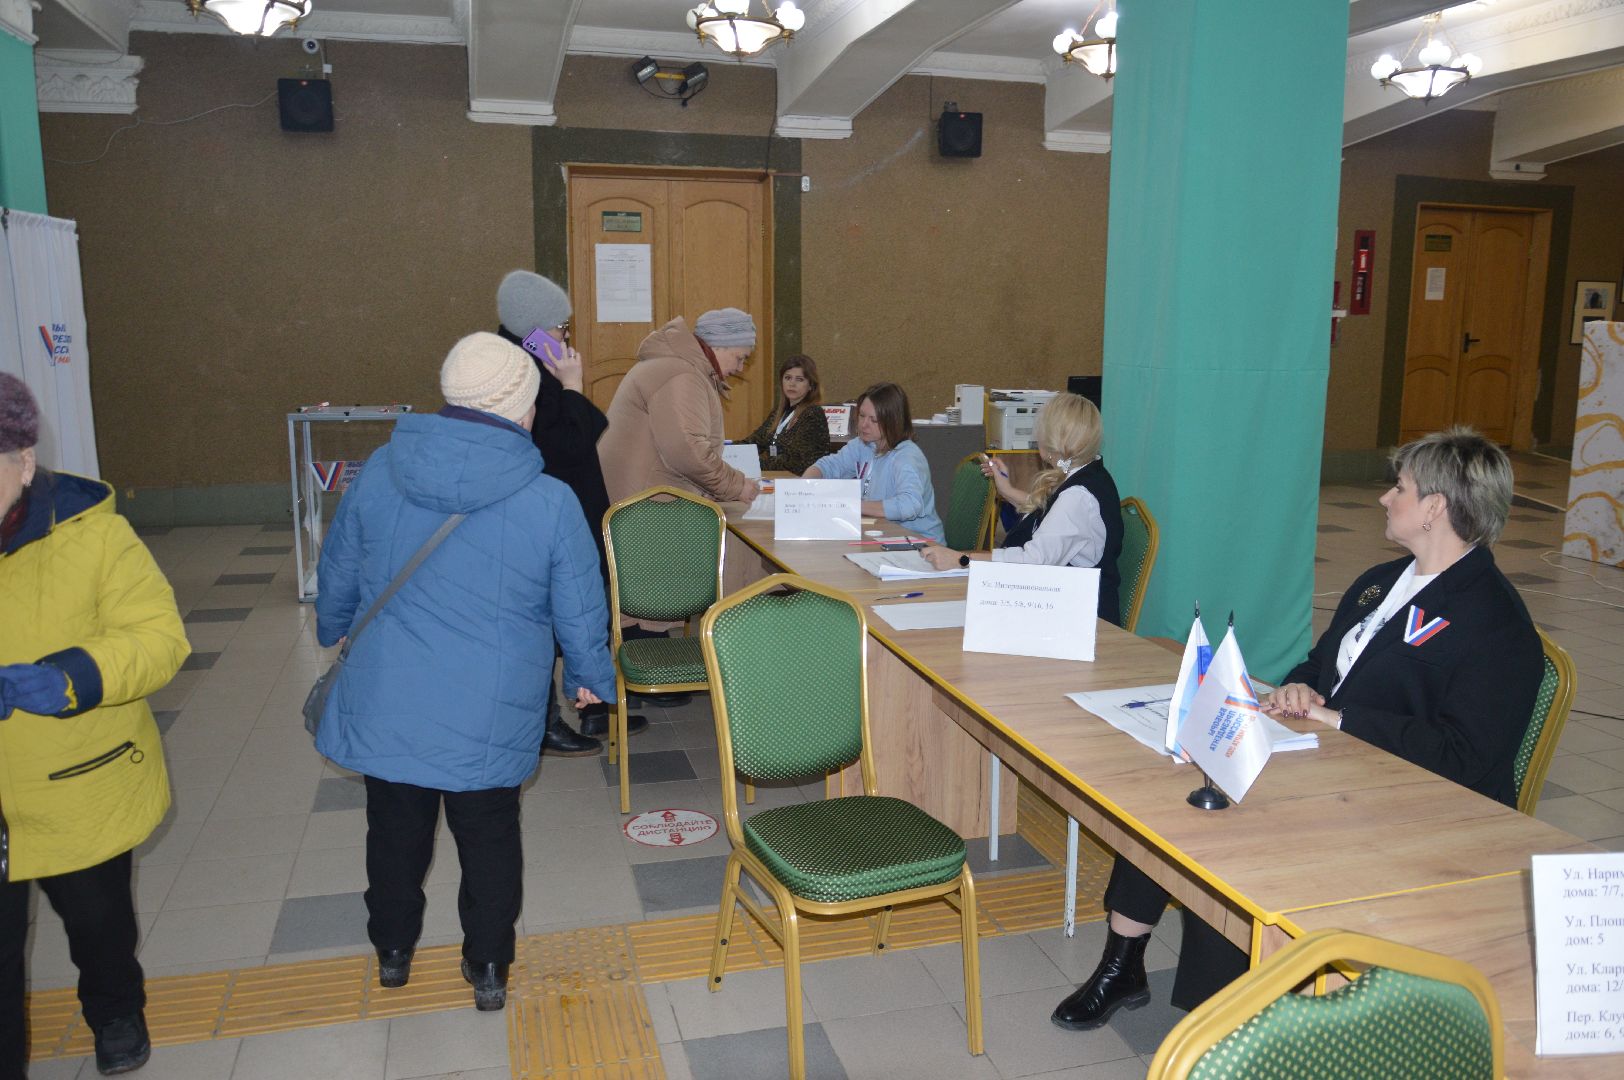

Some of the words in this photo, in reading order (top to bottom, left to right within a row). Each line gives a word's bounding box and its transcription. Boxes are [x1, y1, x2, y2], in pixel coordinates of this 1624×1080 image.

[632, 819, 713, 831] СОБЛЮДАЙТЕ
[637, 825, 712, 836] ДИСТАНЦИЮ
[1563, 867, 1584, 880] Ул.
[1563, 888, 1598, 898] дома:
[1602, 885, 1624, 897] 7/7,
[1564, 915, 1586, 928] Ул.
[1565, 936, 1593, 946] дом:
[1598, 933, 1604, 945] 5
[1567, 963, 1588, 976] Ул.
[1592, 962, 1624, 977] Клар
[1566, 984, 1600, 994] дома:
[1567, 1011, 1594, 1025] Пер.
[1599, 1010, 1624, 1025] Клу
[1565, 1031, 1600, 1041] дома:
